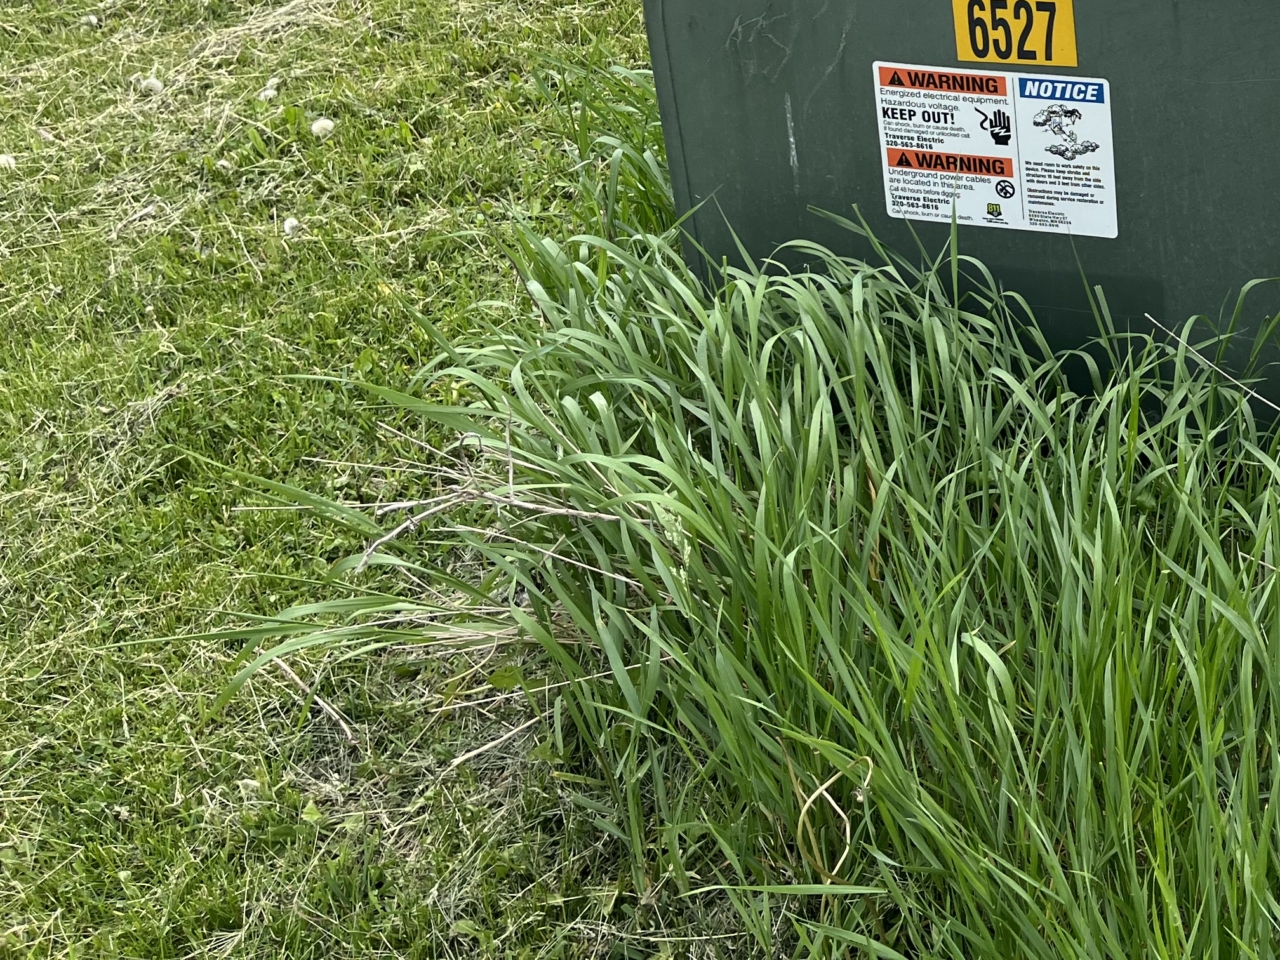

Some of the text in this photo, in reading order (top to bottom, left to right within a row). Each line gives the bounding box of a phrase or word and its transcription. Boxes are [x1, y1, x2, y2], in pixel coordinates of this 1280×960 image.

[907, 72, 998, 93] WARNING
[1024, 80, 1098, 100] NOTICE
[880, 88, 1009, 106] Energized electrical equipment.
[881, 98, 960, 112] Hazardous voltage.
[882, 107, 955, 124] KEEP OUT!
[885, 133, 914, 141] Traverse
[886, 140, 933, 150] 320-563-8616
[915, 152, 1005, 174] WARNING
[888, 168, 991, 184] Underground power cables
[902, 178, 930, 187] located
[892, 200, 938, 210] 320-563-8616
[987, 203, 999, 212] 811
